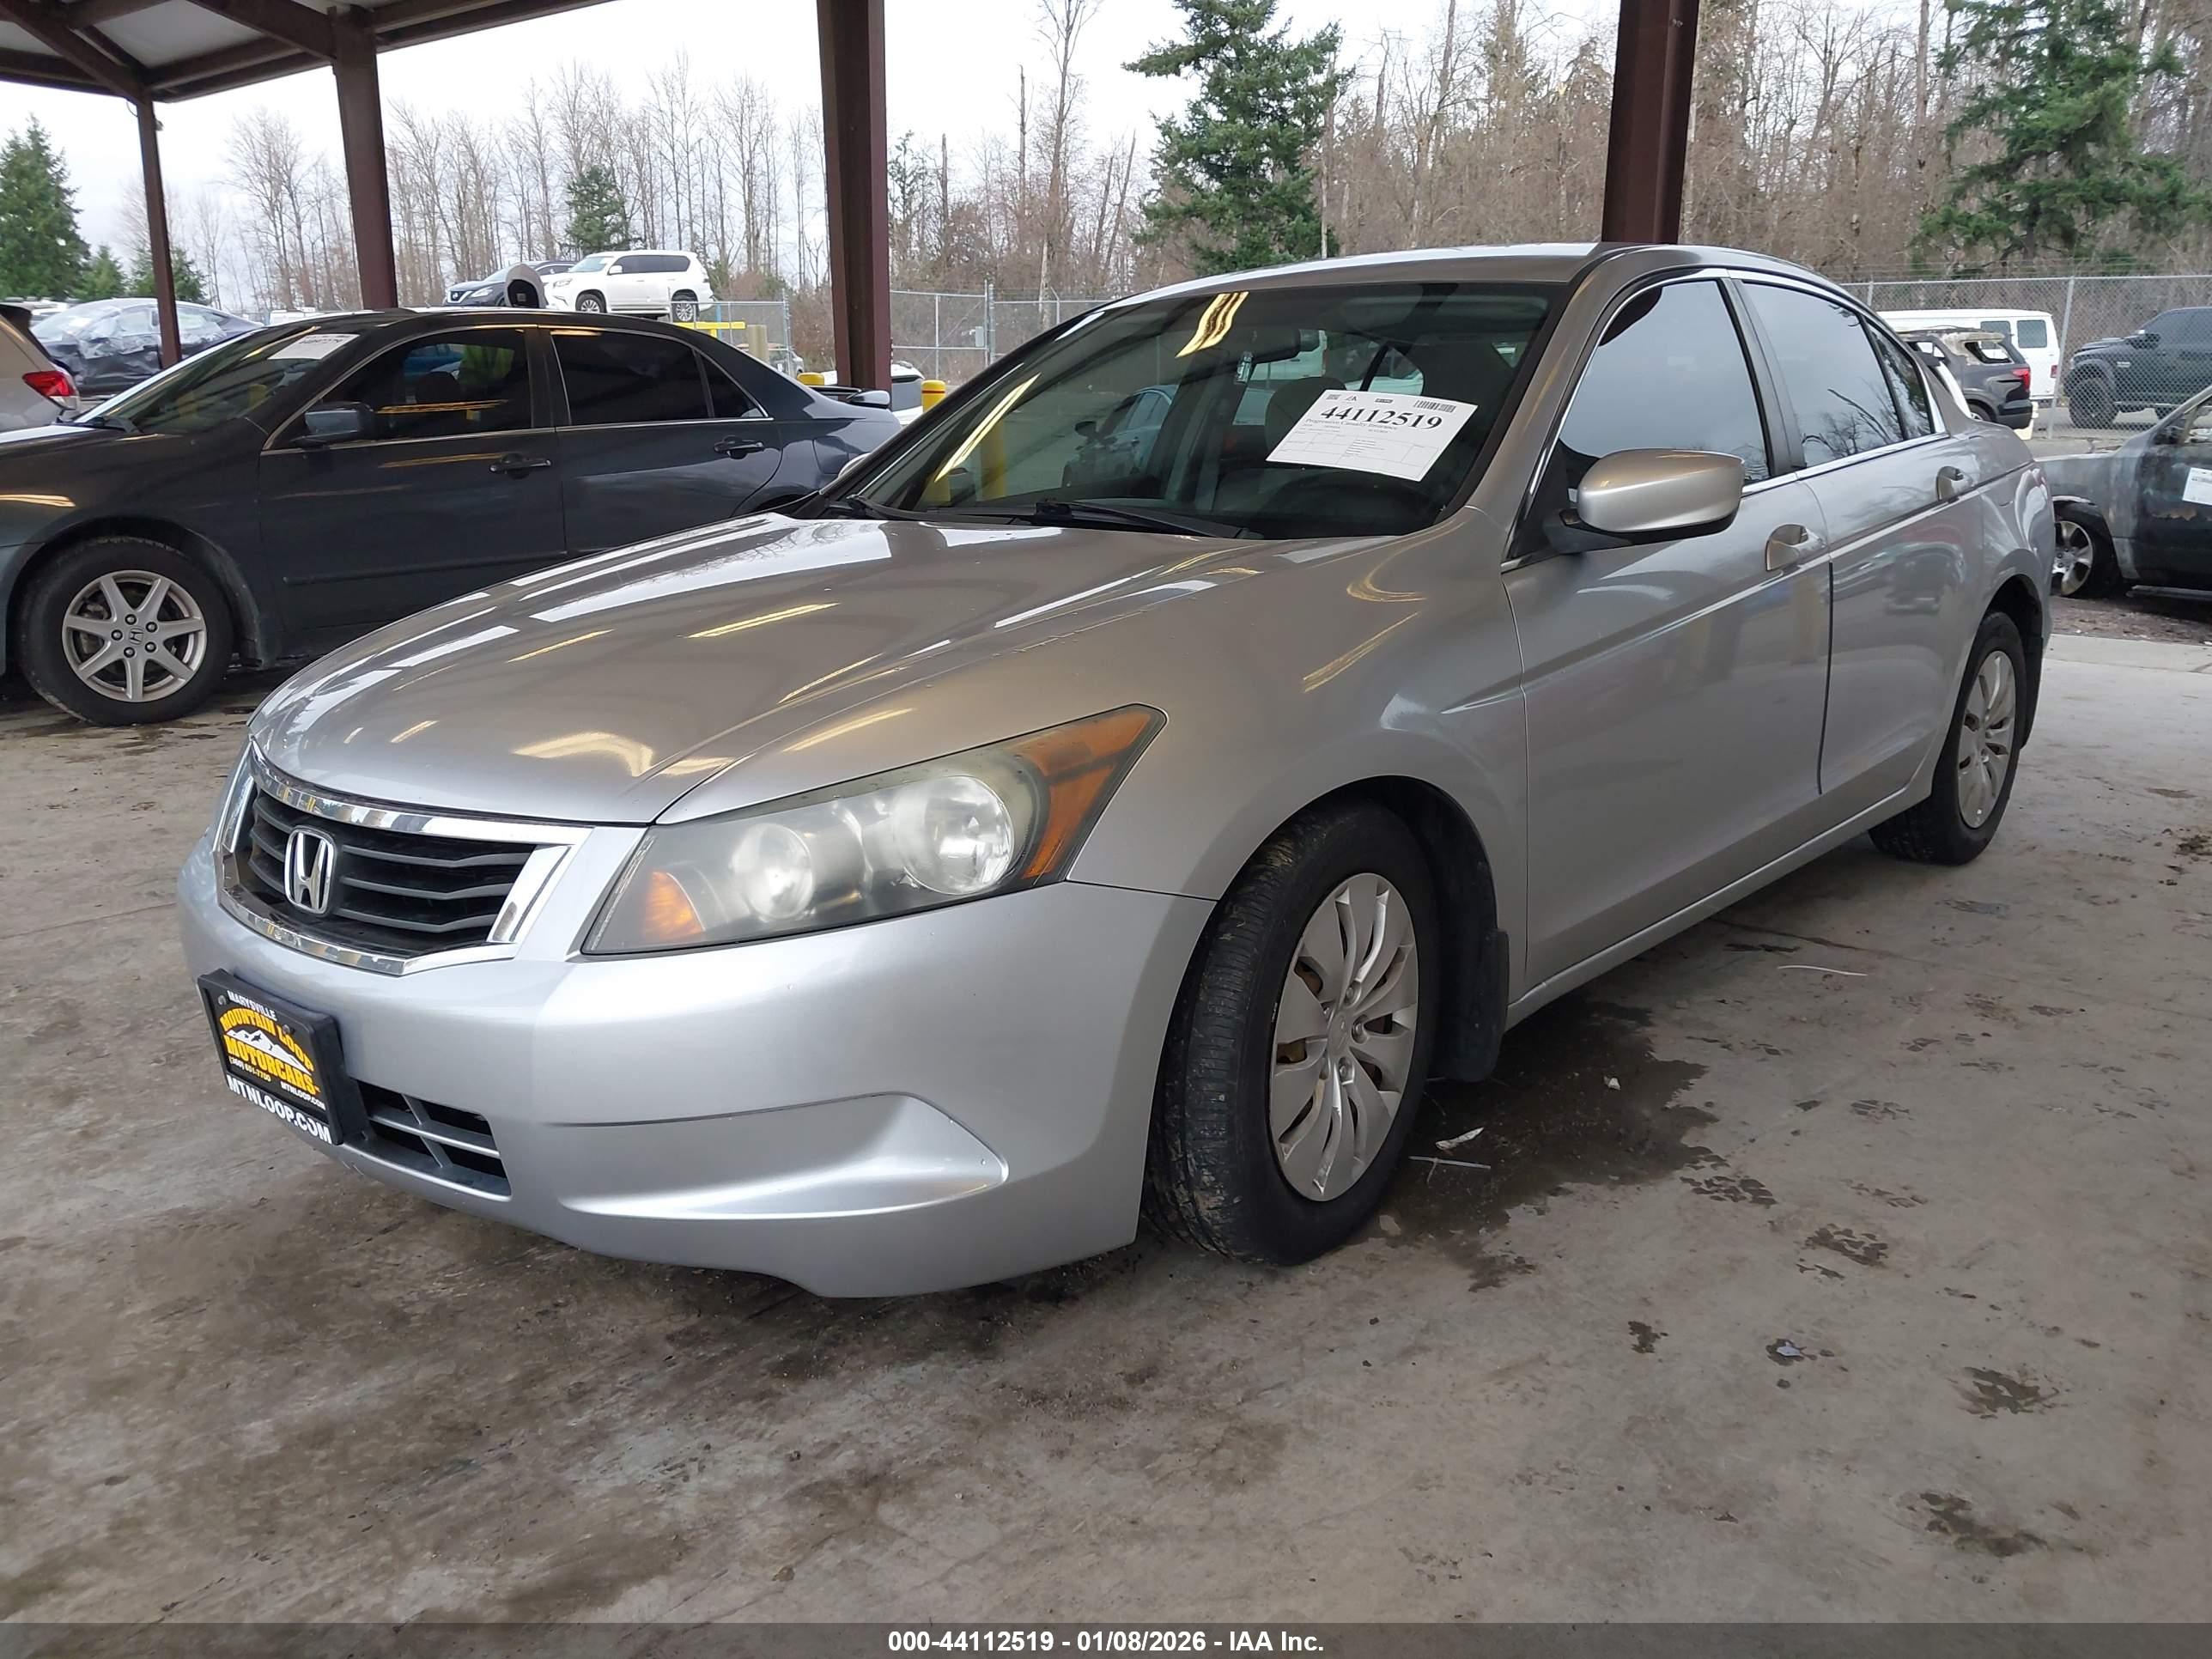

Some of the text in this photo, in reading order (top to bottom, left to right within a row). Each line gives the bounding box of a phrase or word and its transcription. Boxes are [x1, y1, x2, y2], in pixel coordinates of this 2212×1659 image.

[1320, 406, 1443, 430] 44112519
[227, 990, 277, 1022] MARYSVILLE
[220, 1008, 314, 1072] MOUNTAIN LOOP
[223, 1035, 316, 1095] MOTORCARS
[227, 1074, 332, 1144] MTNLOOP.COM
[280, 1081, 326, 1111] MTNLOOP.COM
